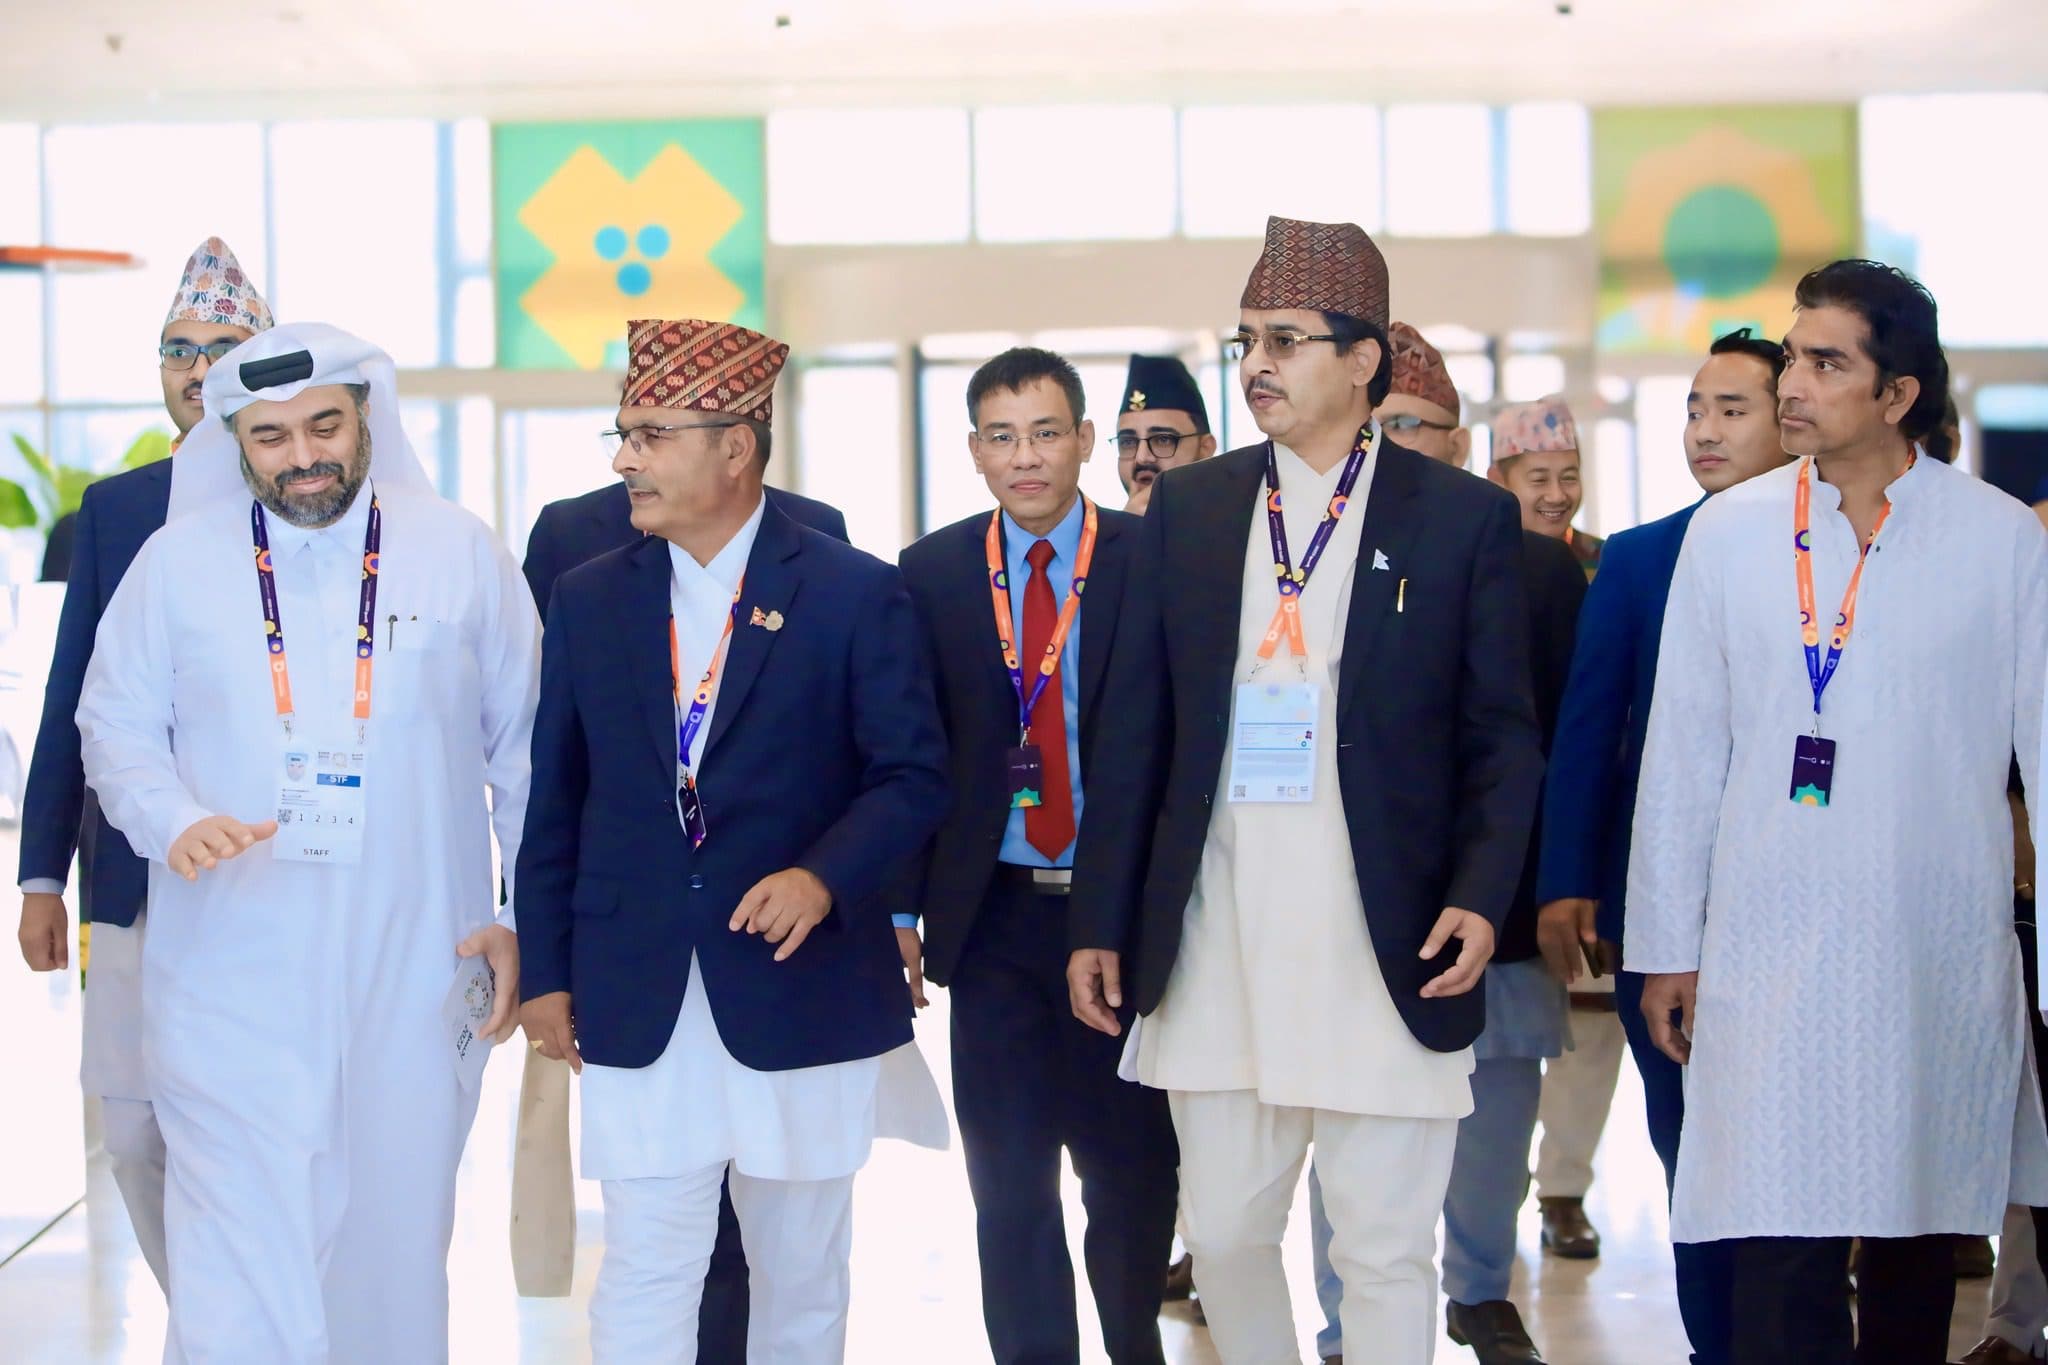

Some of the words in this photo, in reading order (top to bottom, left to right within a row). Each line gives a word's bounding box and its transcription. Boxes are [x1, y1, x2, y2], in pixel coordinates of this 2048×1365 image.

[329, 775, 349, 784] STF
[315, 814, 321, 823] 2
[331, 816, 337, 824] 3
[347, 817, 353, 825] 4
[303, 848, 330, 857] STAFF
